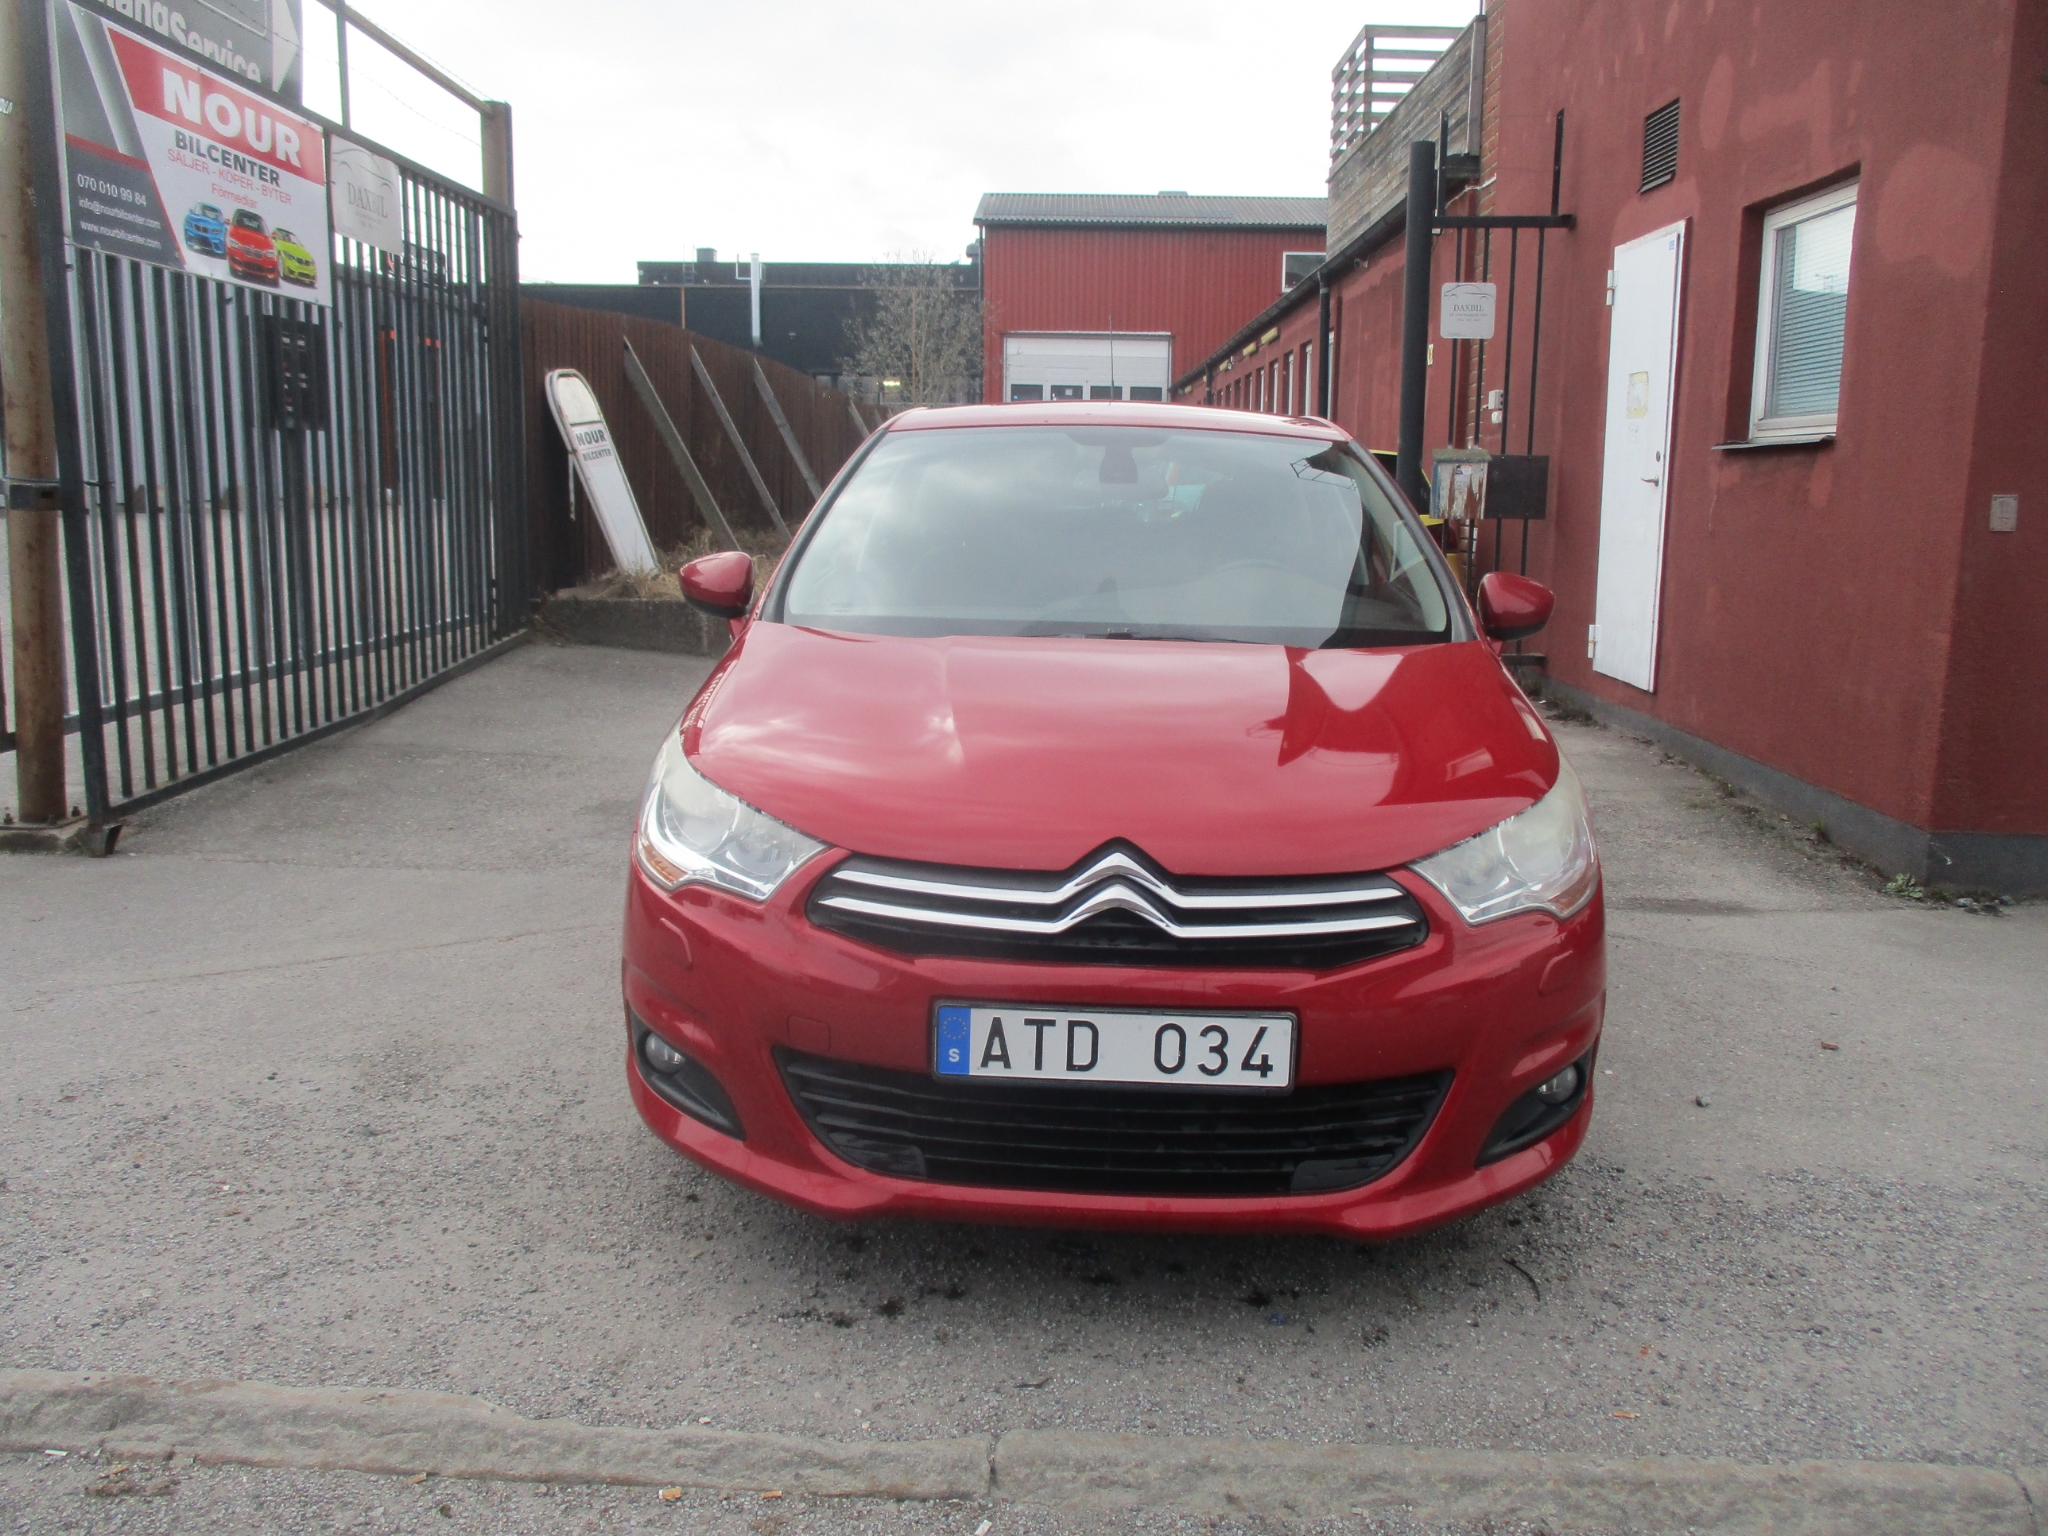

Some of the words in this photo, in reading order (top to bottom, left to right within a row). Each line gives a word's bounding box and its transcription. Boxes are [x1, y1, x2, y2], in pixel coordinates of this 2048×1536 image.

[162, 67, 302, 168] NOUR
[174, 129, 281, 187] BILCENTER
[77, 173, 97, 191] 070
[99, 180, 118, 198] 010
[120, 187, 133, 202] 99
[134, 191, 147, 207] 84
[261, 184, 292, 206] BYTER
[1453, 304, 1484, 312] DAXBIL
[575, 429, 607, 446] NOUR
[582, 448, 612, 461] BILCENTER
[948, 1048, 960, 1063] S
[980, 1016, 1099, 1072] ATD
[1154, 1022, 1274, 1078] 034
